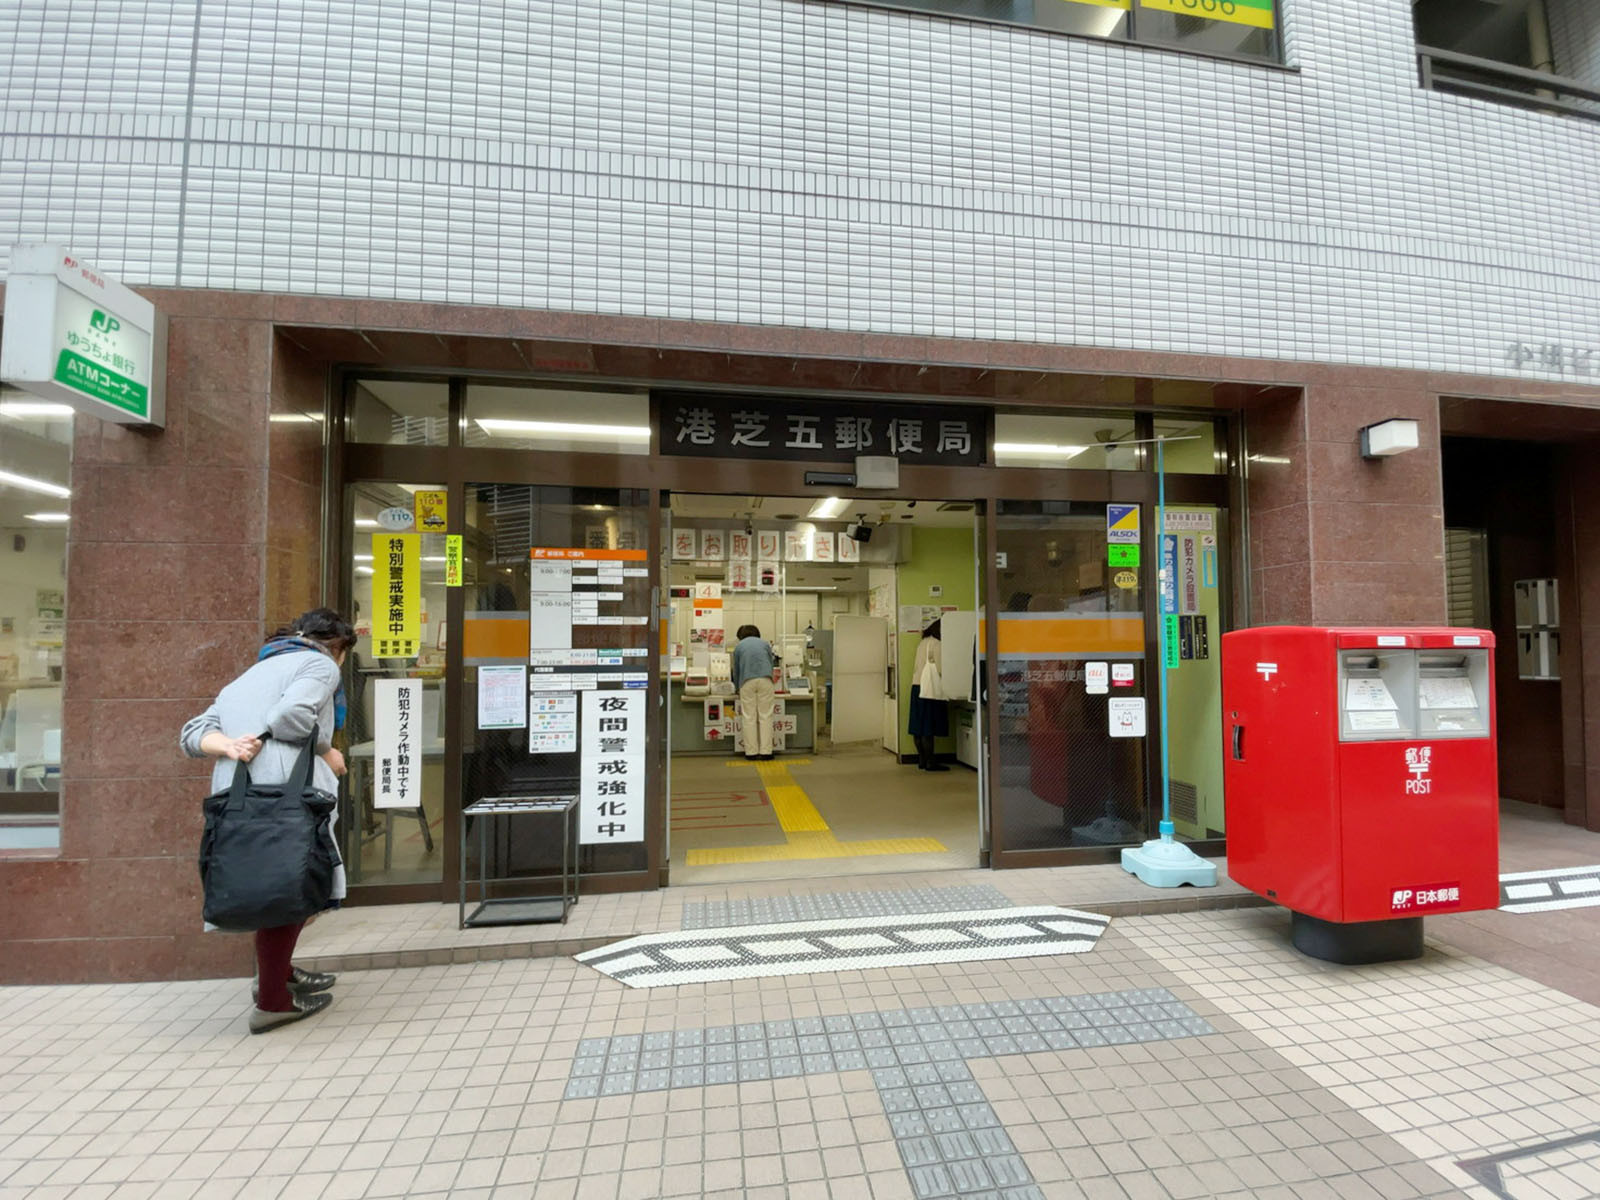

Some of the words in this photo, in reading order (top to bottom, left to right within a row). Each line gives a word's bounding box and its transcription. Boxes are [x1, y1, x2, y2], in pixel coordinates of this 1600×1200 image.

[90, 309, 121, 334] JP
[66, 330, 136, 376] ゆうちょ銀行
[67, 358, 140, 398] ATMコーナー
[675, 407, 972, 455] 港芝五郵便局
[1109, 530, 1138, 538] ALSOK
[388, 538, 405, 636] 特別警戒実施中
[397, 687, 411, 799] 防犯カメラ作動中です
[1405, 746, 1431, 764] 郵便
[381, 758, 391, 793] 郵便局長
[597, 696, 629, 837] 夜間警戒強化中
[1405, 779, 1432, 794] POST
[1416, 887, 1460, 905] 日本郵便
